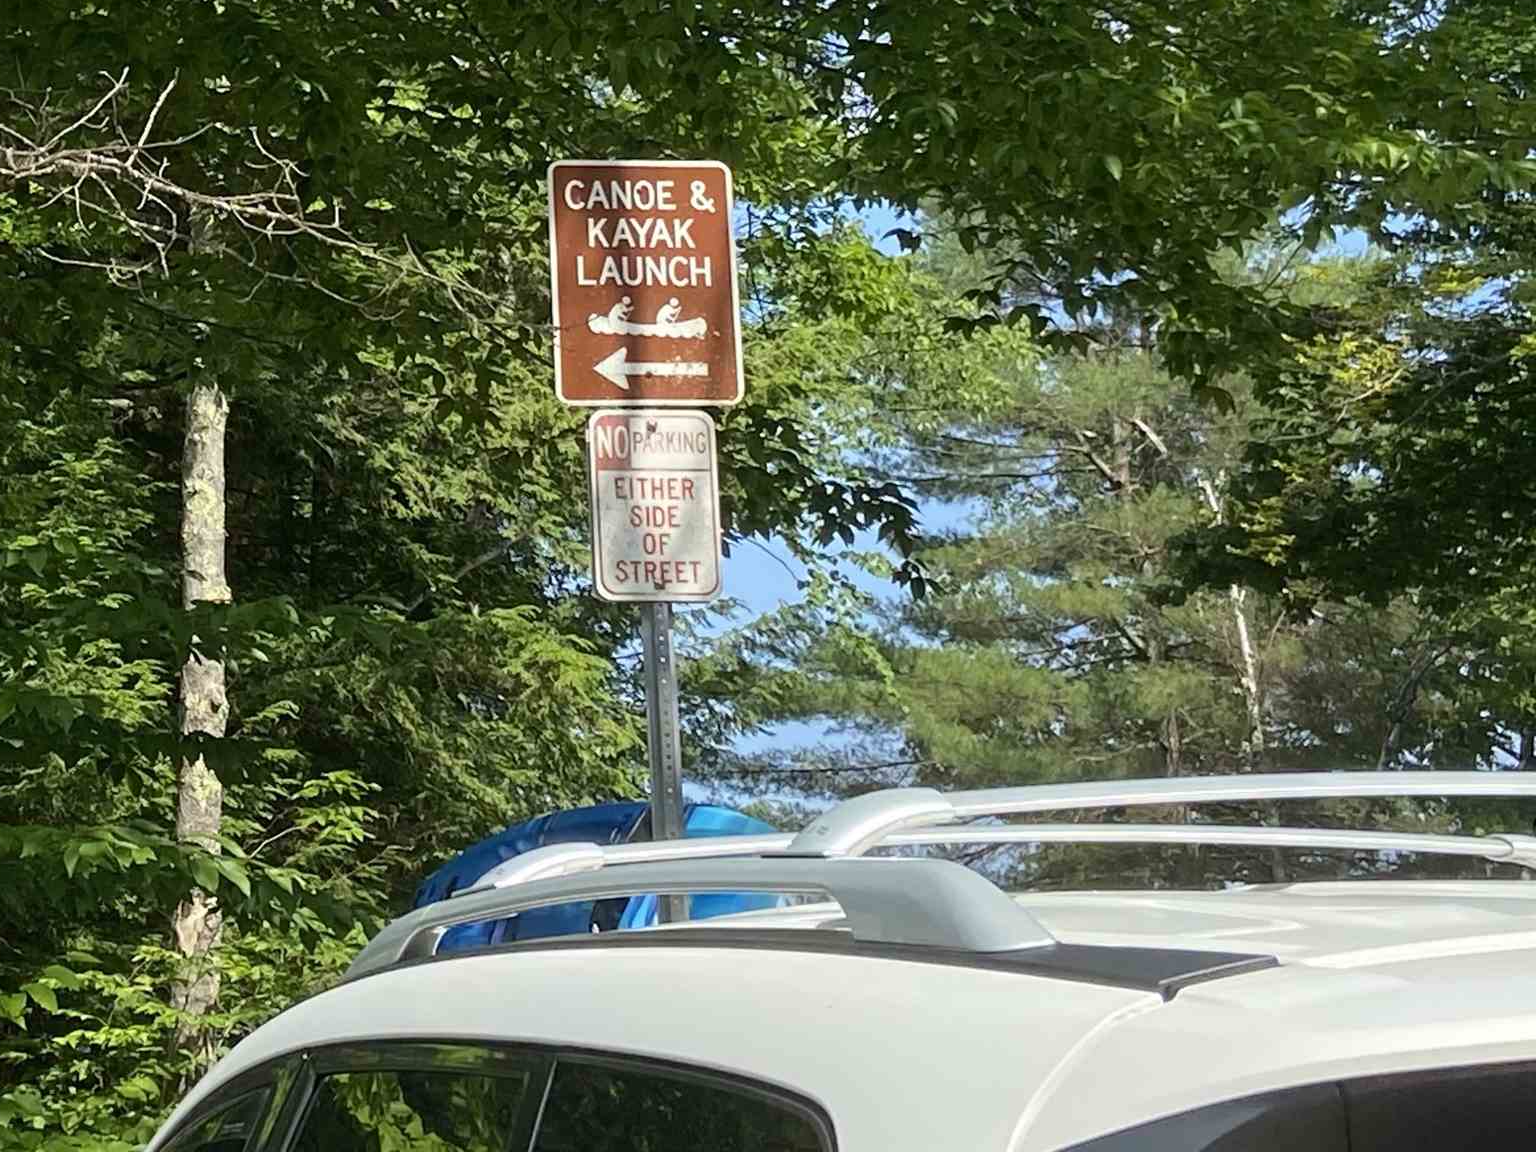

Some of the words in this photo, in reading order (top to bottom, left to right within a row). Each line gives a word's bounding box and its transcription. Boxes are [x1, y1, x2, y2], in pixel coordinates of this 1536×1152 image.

[564, 179, 676, 211] CANOE
[690, 180, 716, 213] &
[587, 217, 696, 249] KAYAK
[576, 255, 712, 287] LAUNCH
[596, 423, 630, 460] NO
[632, 431, 706, 456] PARKING
[615, 477, 695, 500] EITHER
[630, 505, 681, 529] SIDE
[642, 533, 672, 556] OF
[615, 559, 701, 584] STREET
